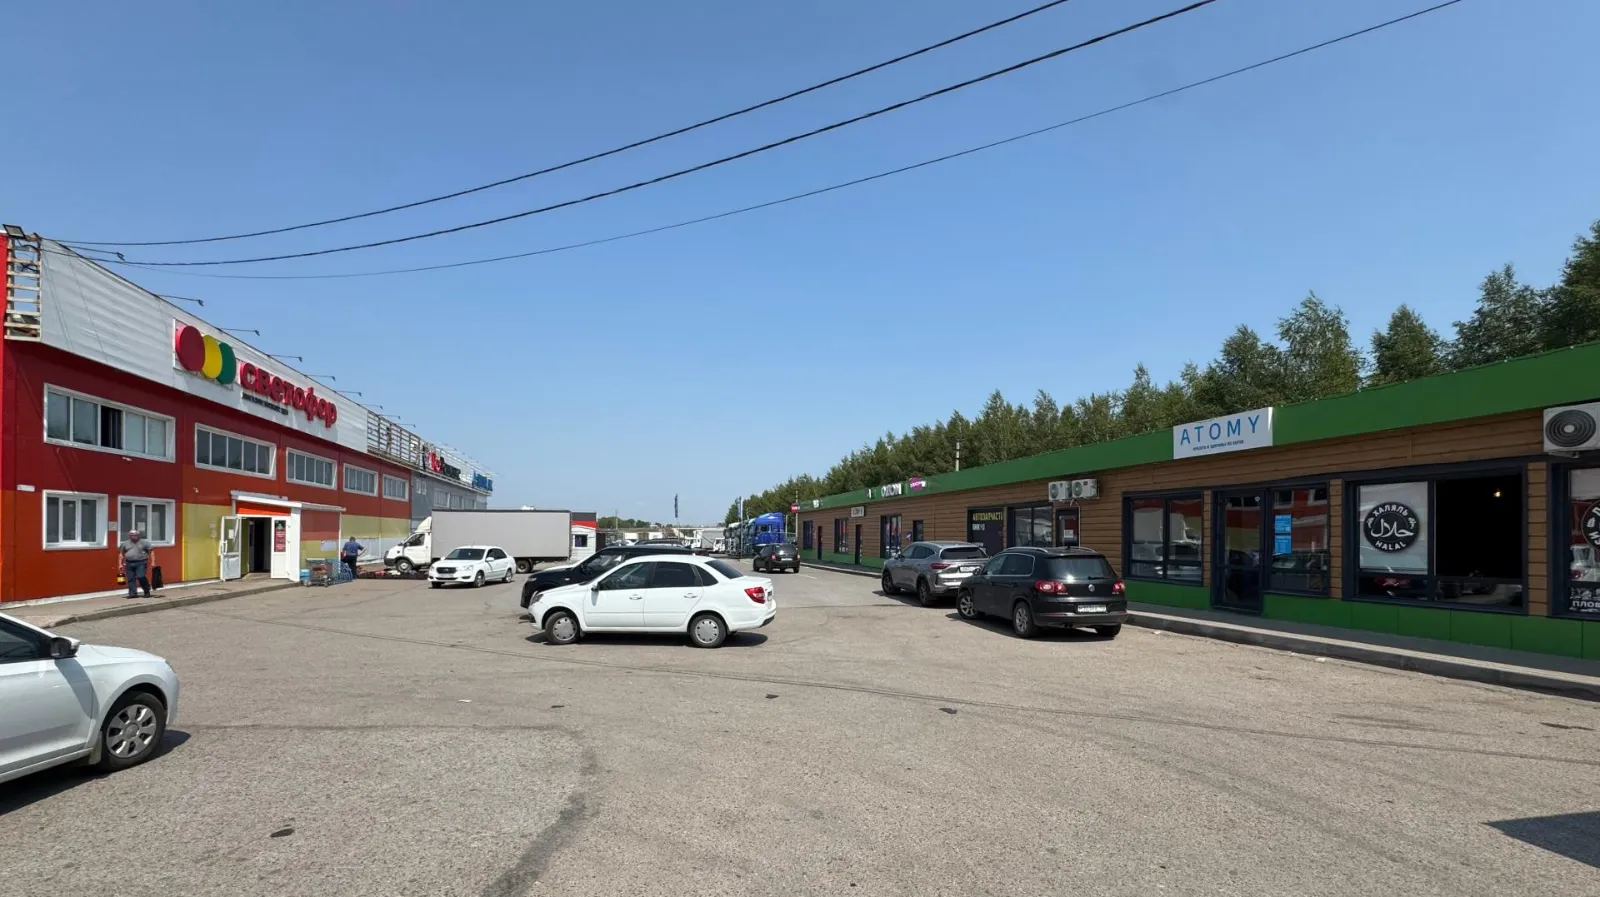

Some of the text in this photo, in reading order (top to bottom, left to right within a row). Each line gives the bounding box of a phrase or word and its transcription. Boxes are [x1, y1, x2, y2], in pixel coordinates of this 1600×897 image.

[1180, 414, 1260, 446] ATOMY
[1372, 504, 1409, 517] ХАЛЯЛЬ
[1370, 518, 1415, 538] حلال
[1375, 540, 1407, 551] HALAL
